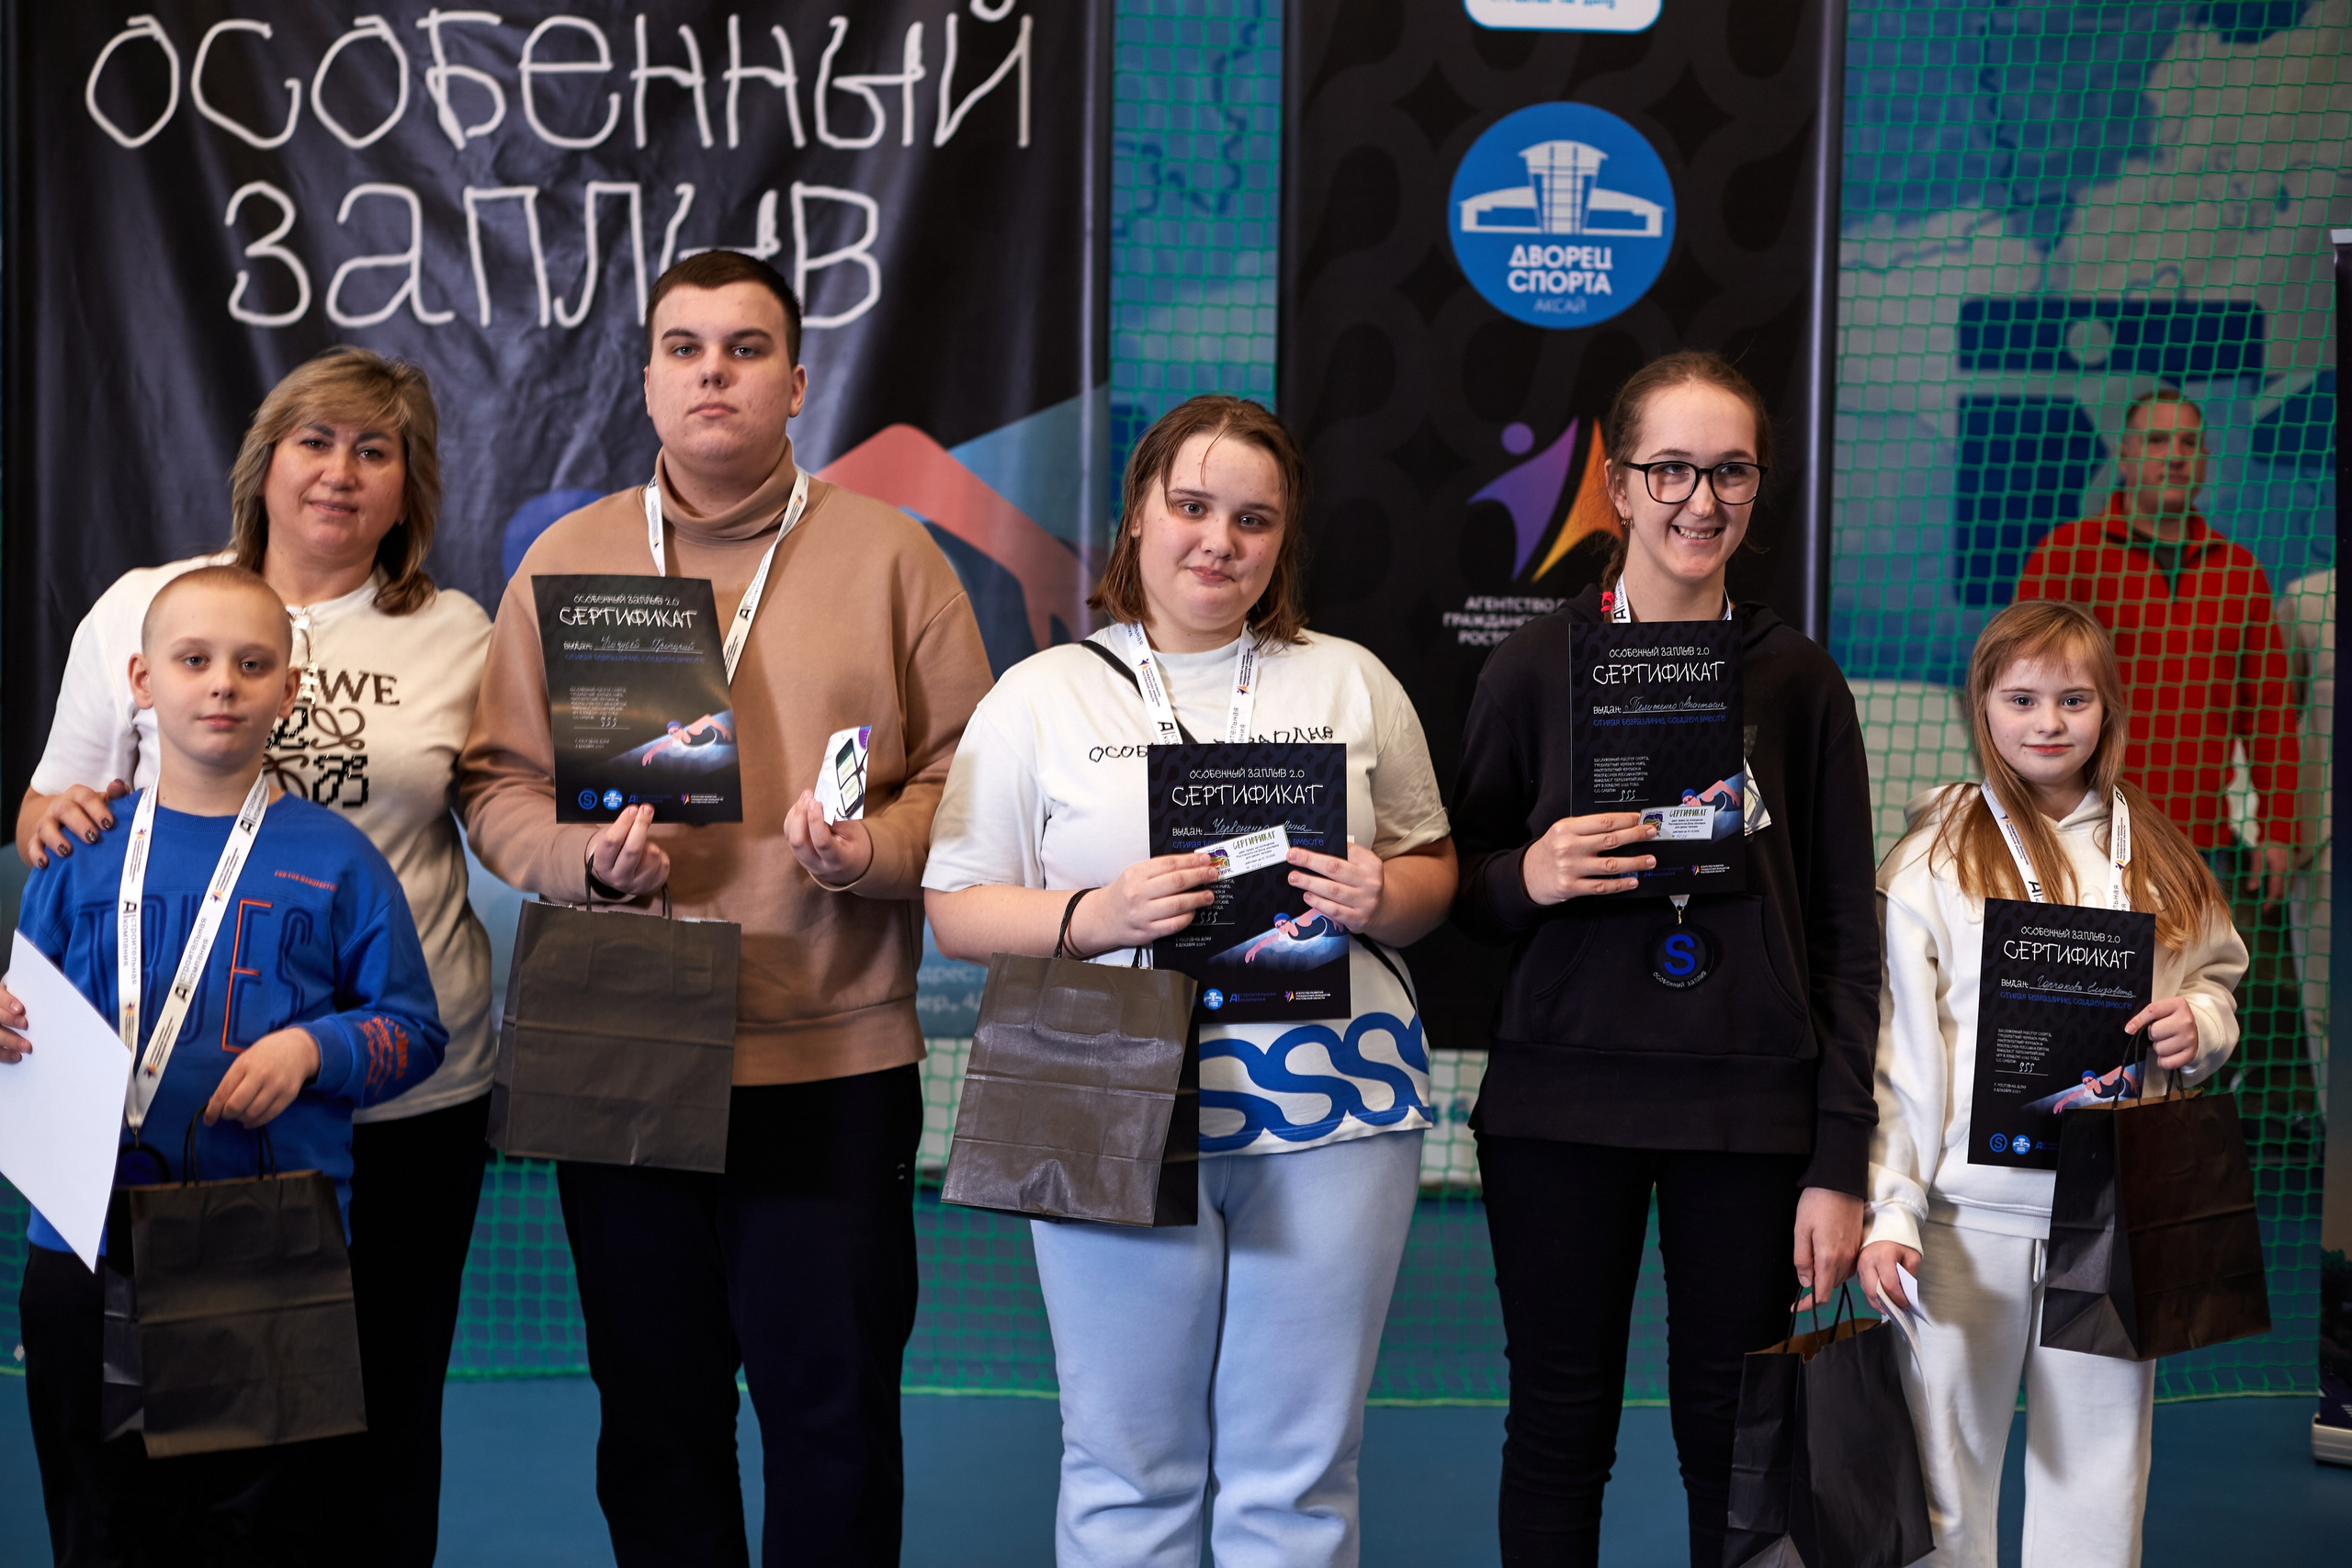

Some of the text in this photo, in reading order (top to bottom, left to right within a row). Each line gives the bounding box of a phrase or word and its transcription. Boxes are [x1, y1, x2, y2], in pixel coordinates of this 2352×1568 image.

[1508, 243, 1613, 270] ДВОРЕЦ
[1507, 270, 1612, 296] СПОРТА
[1533, 297, 1587, 313] АКСАЙ
[665, 598, 680, 606] 2.0
[1464, 596, 1555, 613] АГЕНТСТВО
[560, 606, 698, 629] СЕРТИФИКАТ
[1443, 612, 1532, 628] ГРАЖДАНС
[1609, 646, 1710, 658] ОСОБЕННЫЙ ЗАПЛЫВ 2.0
[1593, 661, 1725, 684] СЕРТИФИКАТ
[1190, 768, 1305, 779] ОСОБЕННЫЙ ЗАПЛЫВ 2.0
[1171, 784, 1324, 807] СЕРТИФИКАТ
[1233, 830, 1275, 850] СЕРТИФИКАТ
[2021, 926, 2120, 943] ОСОБЕННЫЙ ЗАПЛЫВ 2.0
[180, 917, 207, 981] строительная
[1664, 933, 1695, 976] S
[2004, 940, 2135, 969] СЕРТИФИКАТ
[188, 938, 209, 984] компания
[1995, 1137, 2003, 1149] S
